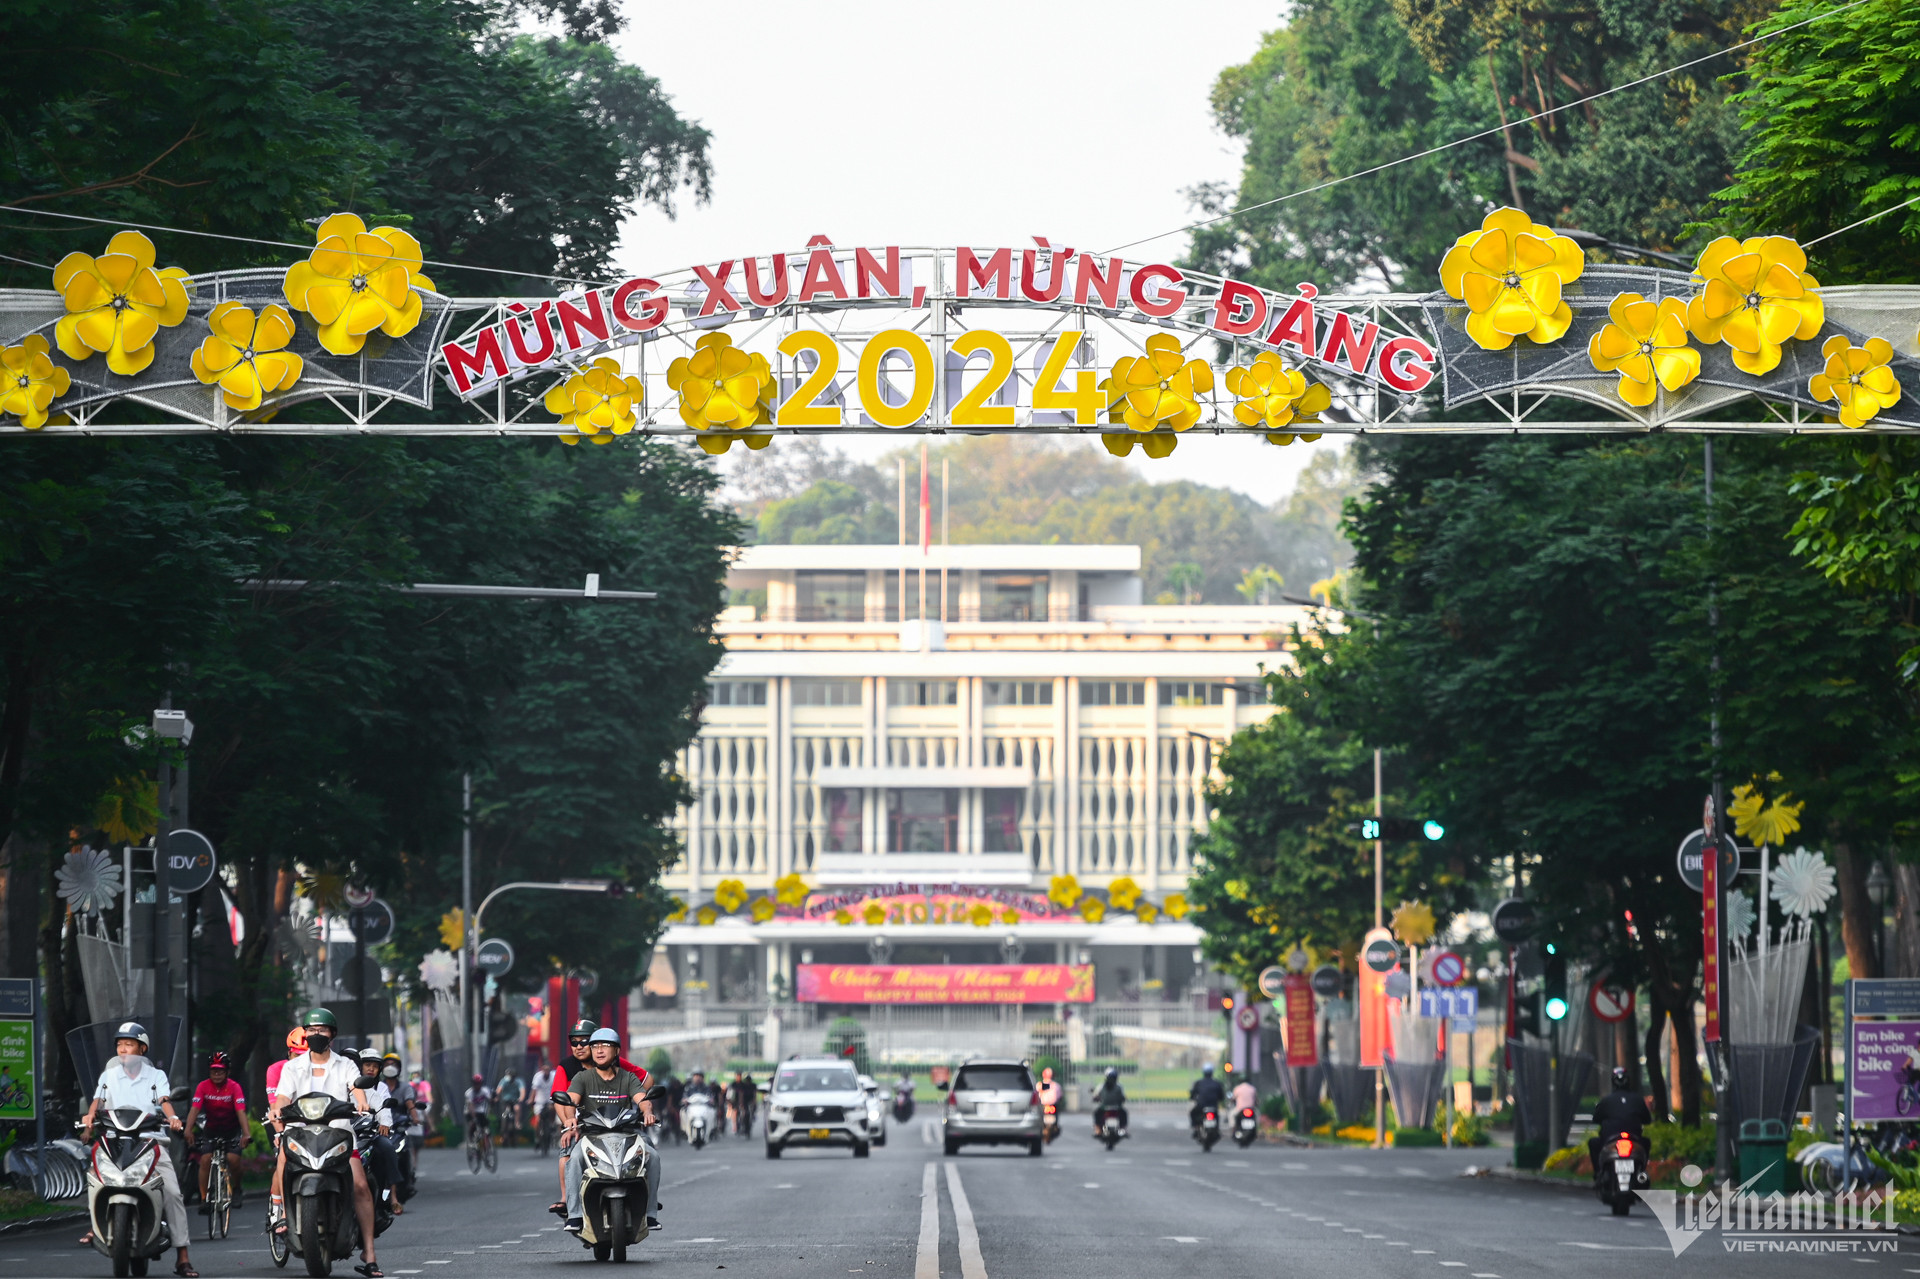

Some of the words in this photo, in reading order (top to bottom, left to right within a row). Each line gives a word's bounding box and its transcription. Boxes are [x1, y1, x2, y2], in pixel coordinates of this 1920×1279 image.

[440, 277, 670, 395] MỪNG
[690, 234, 926, 317] XUÂN,
[956, 236, 1187, 318] MỪNG
[1212, 280, 1436, 393] ĐẢNG
[776, 329, 1107, 428] 2024
[168, 855, 196, 870] IDV
[915, 989, 949, 1001] NEW
[953, 989, 991, 1001] YEAR
[1880, 1030, 1905, 1042] bike
[1858, 1057, 1893, 1072] bike
